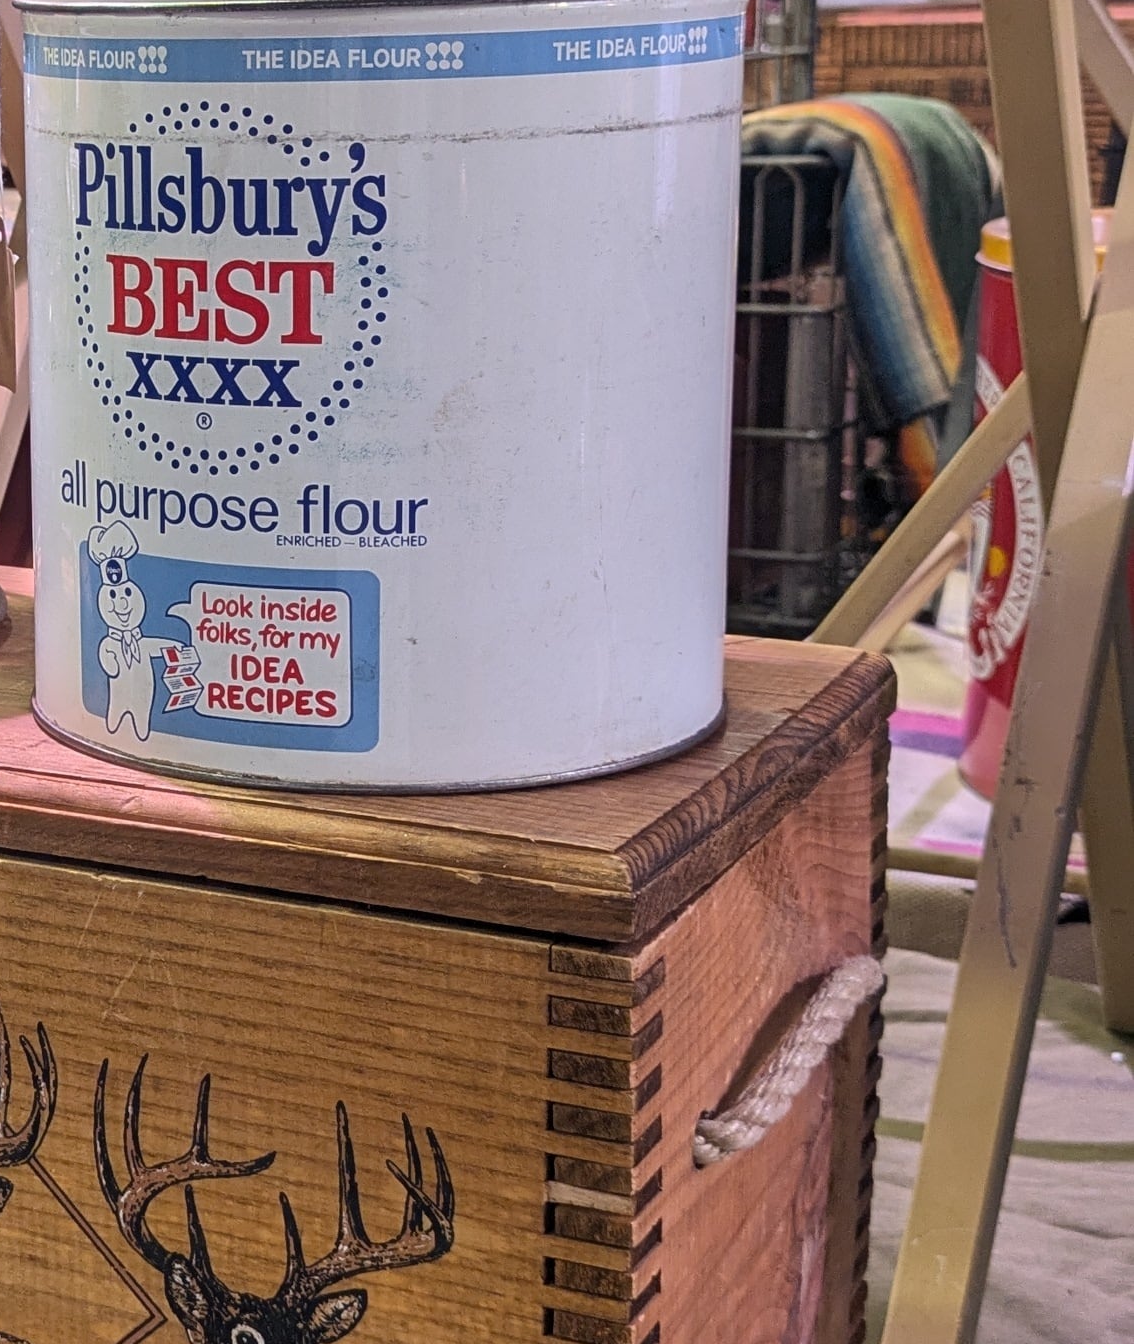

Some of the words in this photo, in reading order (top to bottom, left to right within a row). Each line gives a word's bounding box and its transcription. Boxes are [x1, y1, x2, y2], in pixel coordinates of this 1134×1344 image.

[43, 46, 59, 66] THE
[60, 47, 86, 68] IDEA
[241, 49, 284, 69] THE
[290, 49, 341, 70] IDEA
[552, 39, 591, 62] THE
[596, 37, 636, 59] IDEA
[74, 141, 388, 257] Pillsbury's
[105, 253, 335, 346] BEST
[125, 351, 303, 409] XXXX
[61, 460, 87, 508] all
[96, 477, 279, 534] purpose
[296, 483, 429, 536] flour
[276, 534, 342, 548] ENRICHED
[358, 535, 428, 549] BLEACHED
[201, 591, 254, 619] Look
[260, 594, 338, 623] inside
[196, 617, 258, 652] folks,
[258, 623, 295, 649] for
[299, 631, 341, 659] my
[230, 653, 304, 685] IDEA
[206, 682, 338, 718] RECIPES
